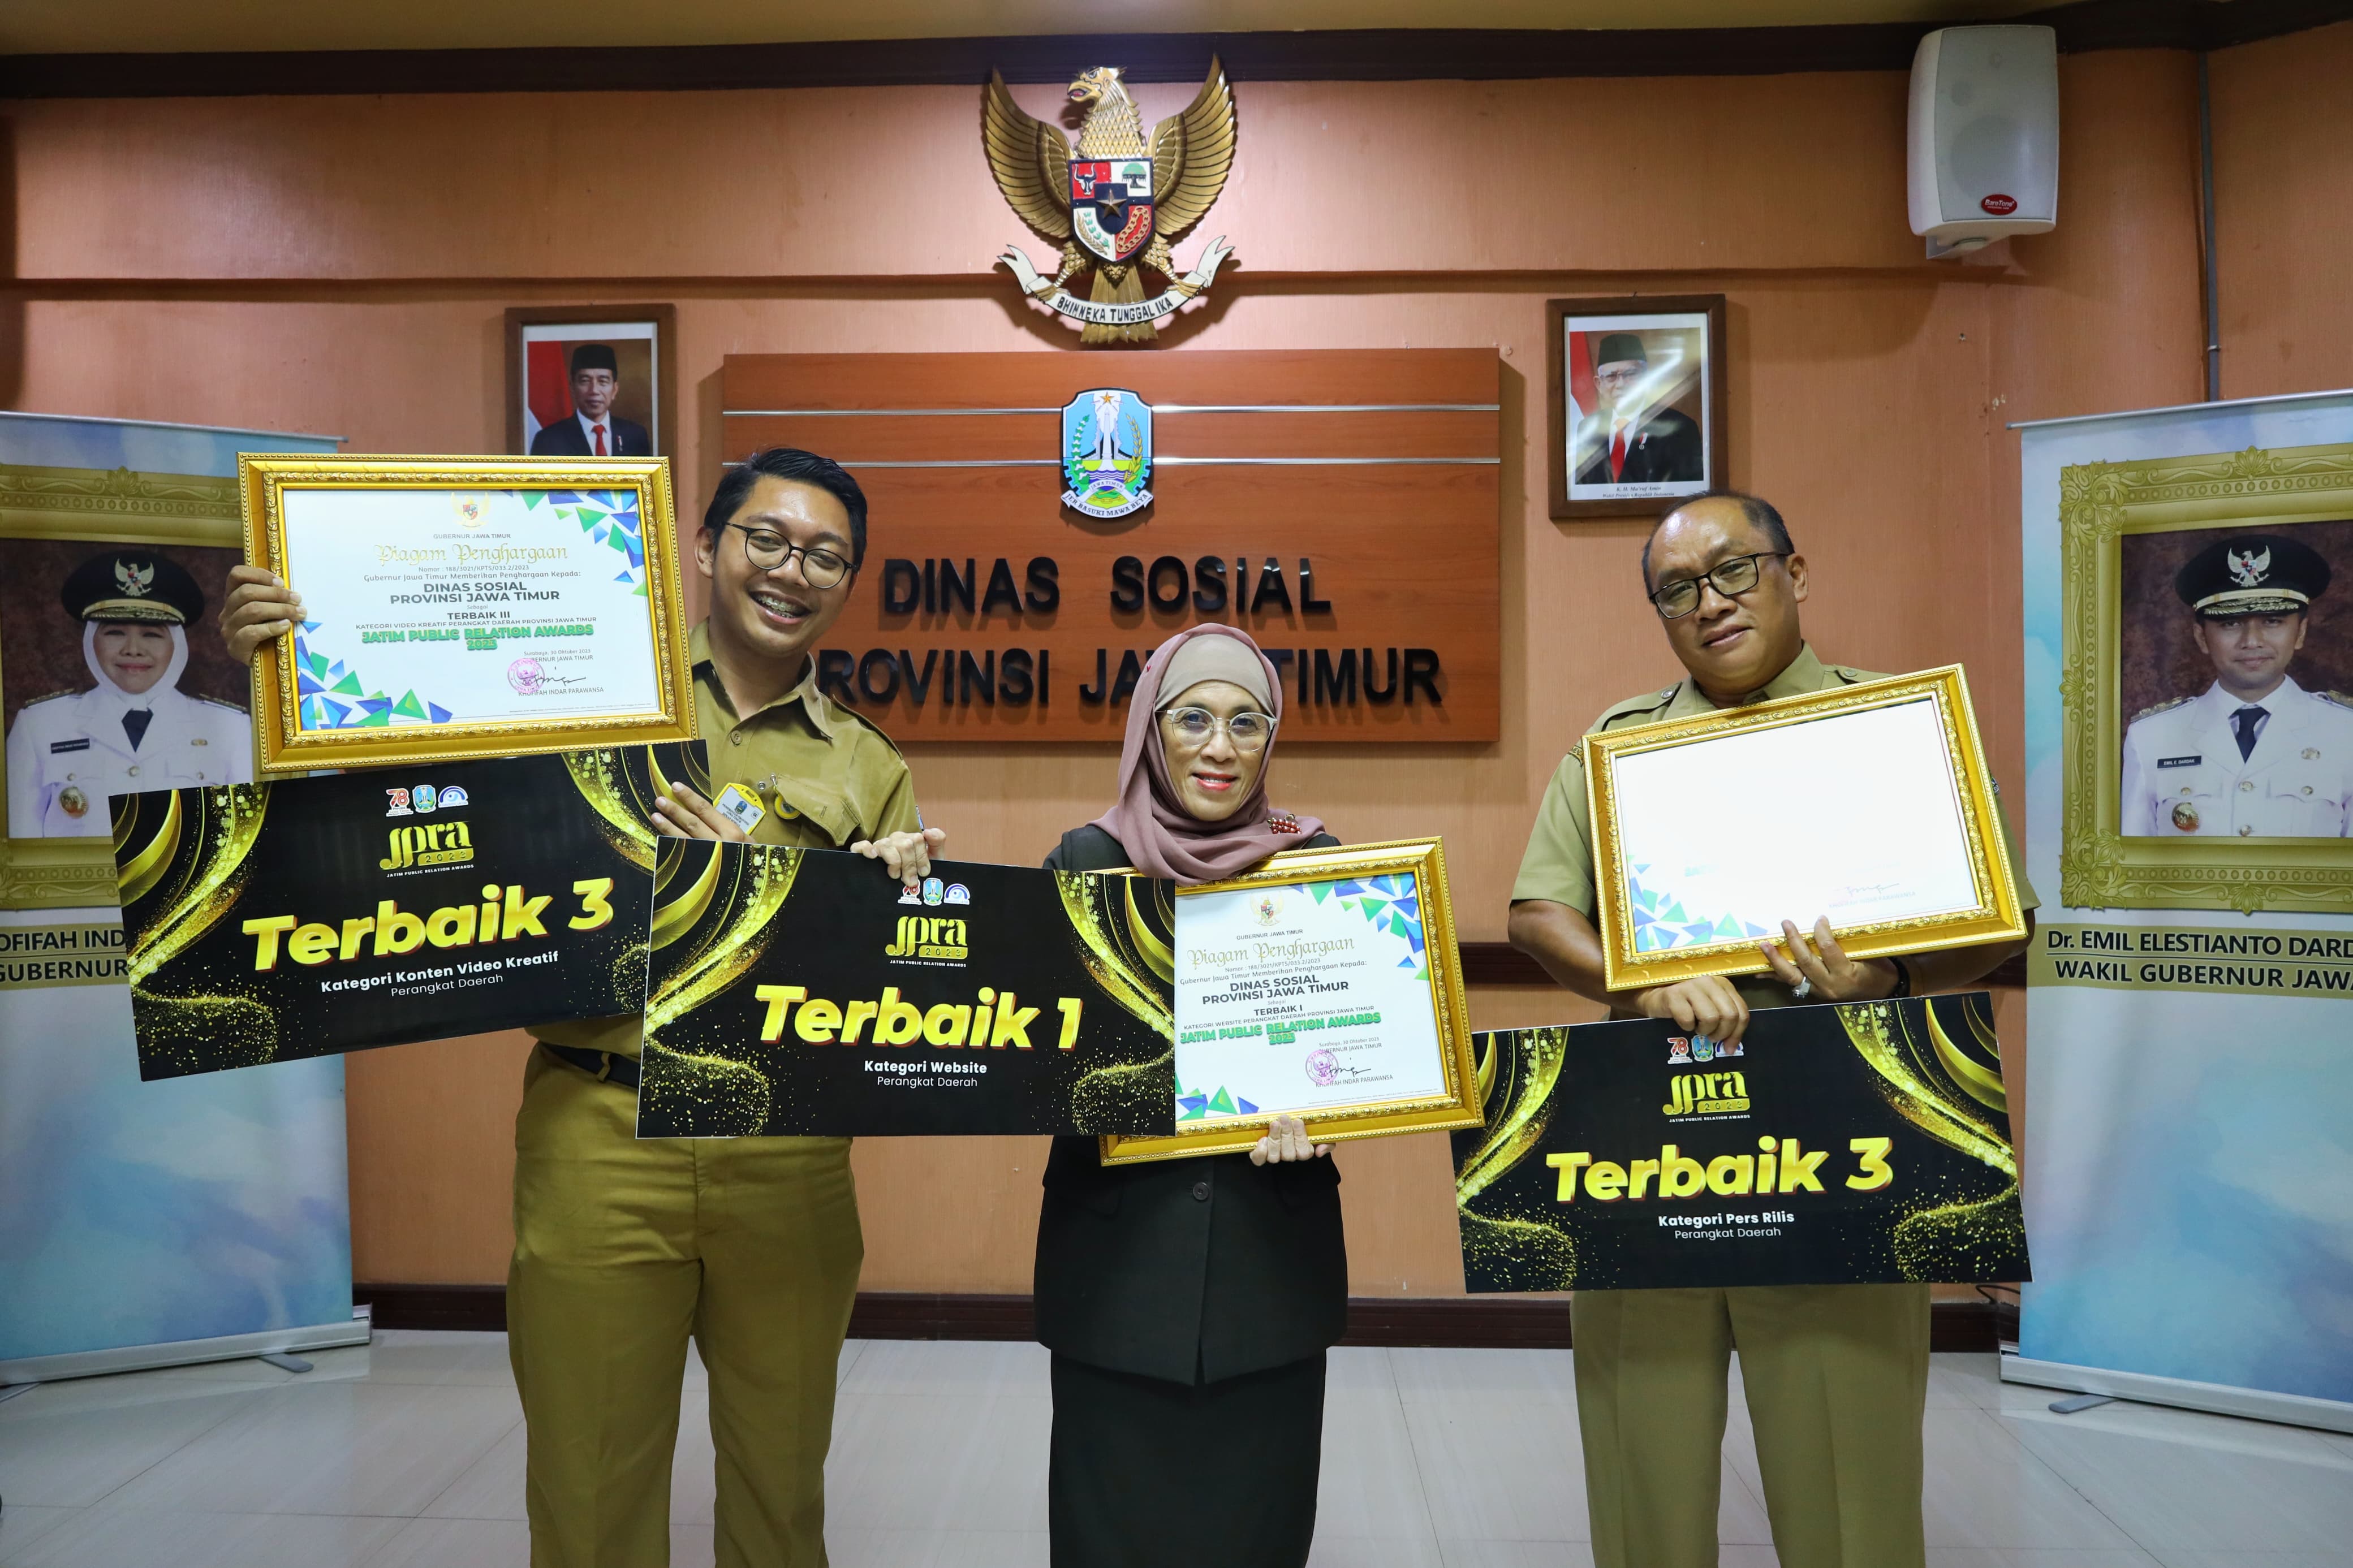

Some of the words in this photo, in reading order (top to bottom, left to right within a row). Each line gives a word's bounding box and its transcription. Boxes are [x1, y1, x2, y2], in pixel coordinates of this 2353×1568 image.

[1057, 296, 1105, 322] BHINNEKA
[1110, 304, 1154, 322] TUNGGAL
[1155, 297, 1173, 314] IKA
[1091, 481, 1105, 489] JAWA
[1105, 481, 1123, 489] TIMUR
[1065, 493, 1077, 504] JER
[1078, 502, 1104, 516] BASUKI
[1106, 507, 1130, 516] MAWA
[1131, 494, 1148, 508] BEYA
[373, 544, 446, 567] Piagam
[452, 543, 568, 565] Penghargaan
[424, 583, 470, 593] DINAS
[475, 581, 527, 591] SOSIAL
[884, 556, 1060, 614] DINAS
[1110, 556, 1331, 613] SOSIAL
[390, 594, 462, 604] PROVINSI
[467, 593, 510, 603] JAWA
[514, 591, 559, 601] TIMUR
[447, 611, 497, 620] TERBAIK
[362, 630, 405, 643] JATIM
[408, 629, 460, 641] PUBLIC
[464, 627, 531, 640] RELATION
[534, 624, 593, 637] AWARDS
[467, 639, 498, 650] 2023
[820, 648, 1049, 705] ROVINSI
[1079, 649, 1154, 704] JA
[426, 850, 466, 863] 2023
[243, 884, 553, 972] Terbaik
[568, 878, 614, 932] 3
[0, 931, 77, 951] OFIFAH
[85, 930, 126, 948] IND
[2048, 930, 2074, 949] Dr.
[2082, 931, 2134, 952] EMIL
[2140, 932, 2281, 956] ELESTIANTO
[926, 948, 961, 957] 2023
[1187, 948, 1248, 970] Piagam
[1253, 938, 1354, 962] Penghargaan
[321, 973, 393, 993] Kategori
[396, 966, 454, 984] Konten
[457, 959, 502, 975] Video
[506, 950, 559, 969] Kreatif
[1180, 977, 1210, 986] Gubernur
[1252, 968, 1293, 977] Memberikan
[1295, 964, 1338, 974] Penghargaan
[1340, 960, 1367, 969] Kepada:
[2054, 960, 2132, 982] WAKIL
[2140, 964, 2284, 987] GUBERNUR
[2291, 969, 2353, 990] JAW
[391, 980, 455, 997] Perangkat
[459, 973, 503, 989] Daerah
[1230, 979, 1270, 991] DINAS
[1273, 974, 1320, 987] SOSIAL
[1203, 991, 1263, 1005] PROVINSI
[1266, 986, 1305, 998] JAWA
[1308, 981, 1348, 994] TIMUR
[755, 984, 1040, 1050] Terbaik
[1057, 997, 1084, 1051] 1
[1254, 1005, 1296, 1016] TERBAIK
[1180, 1030, 1216, 1044] JATIM
[1219, 1025, 1262, 1039] PUBLIC
[1266, 1018, 1325, 1035] RELATION
[1328, 1012, 1381, 1028] AWARDS
[1268, 1033, 1296, 1045] 2023
[864, 1060, 926, 1075] Kategori
[930, 1061, 987, 1074] Website
[877, 1076, 934, 1089] Perangkat
[937, 1077, 977, 1087] Daerah
[1360, 1074, 1393, 1083] PARAWANSA
[1705, 1101, 1743, 1111] 2023
[1545, 1136, 1830, 1204] Terbaik
[1845, 1137, 1894, 1193] 3
[1658, 1212, 1723, 1229] Kategori
[1726, 1212, 1759, 1224] Pers
[1762, 1210, 1794, 1224] Rilis
[1675, 1228, 1734, 1241] Perangkat
[1738, 1226, 1781, 1238] Daerah
